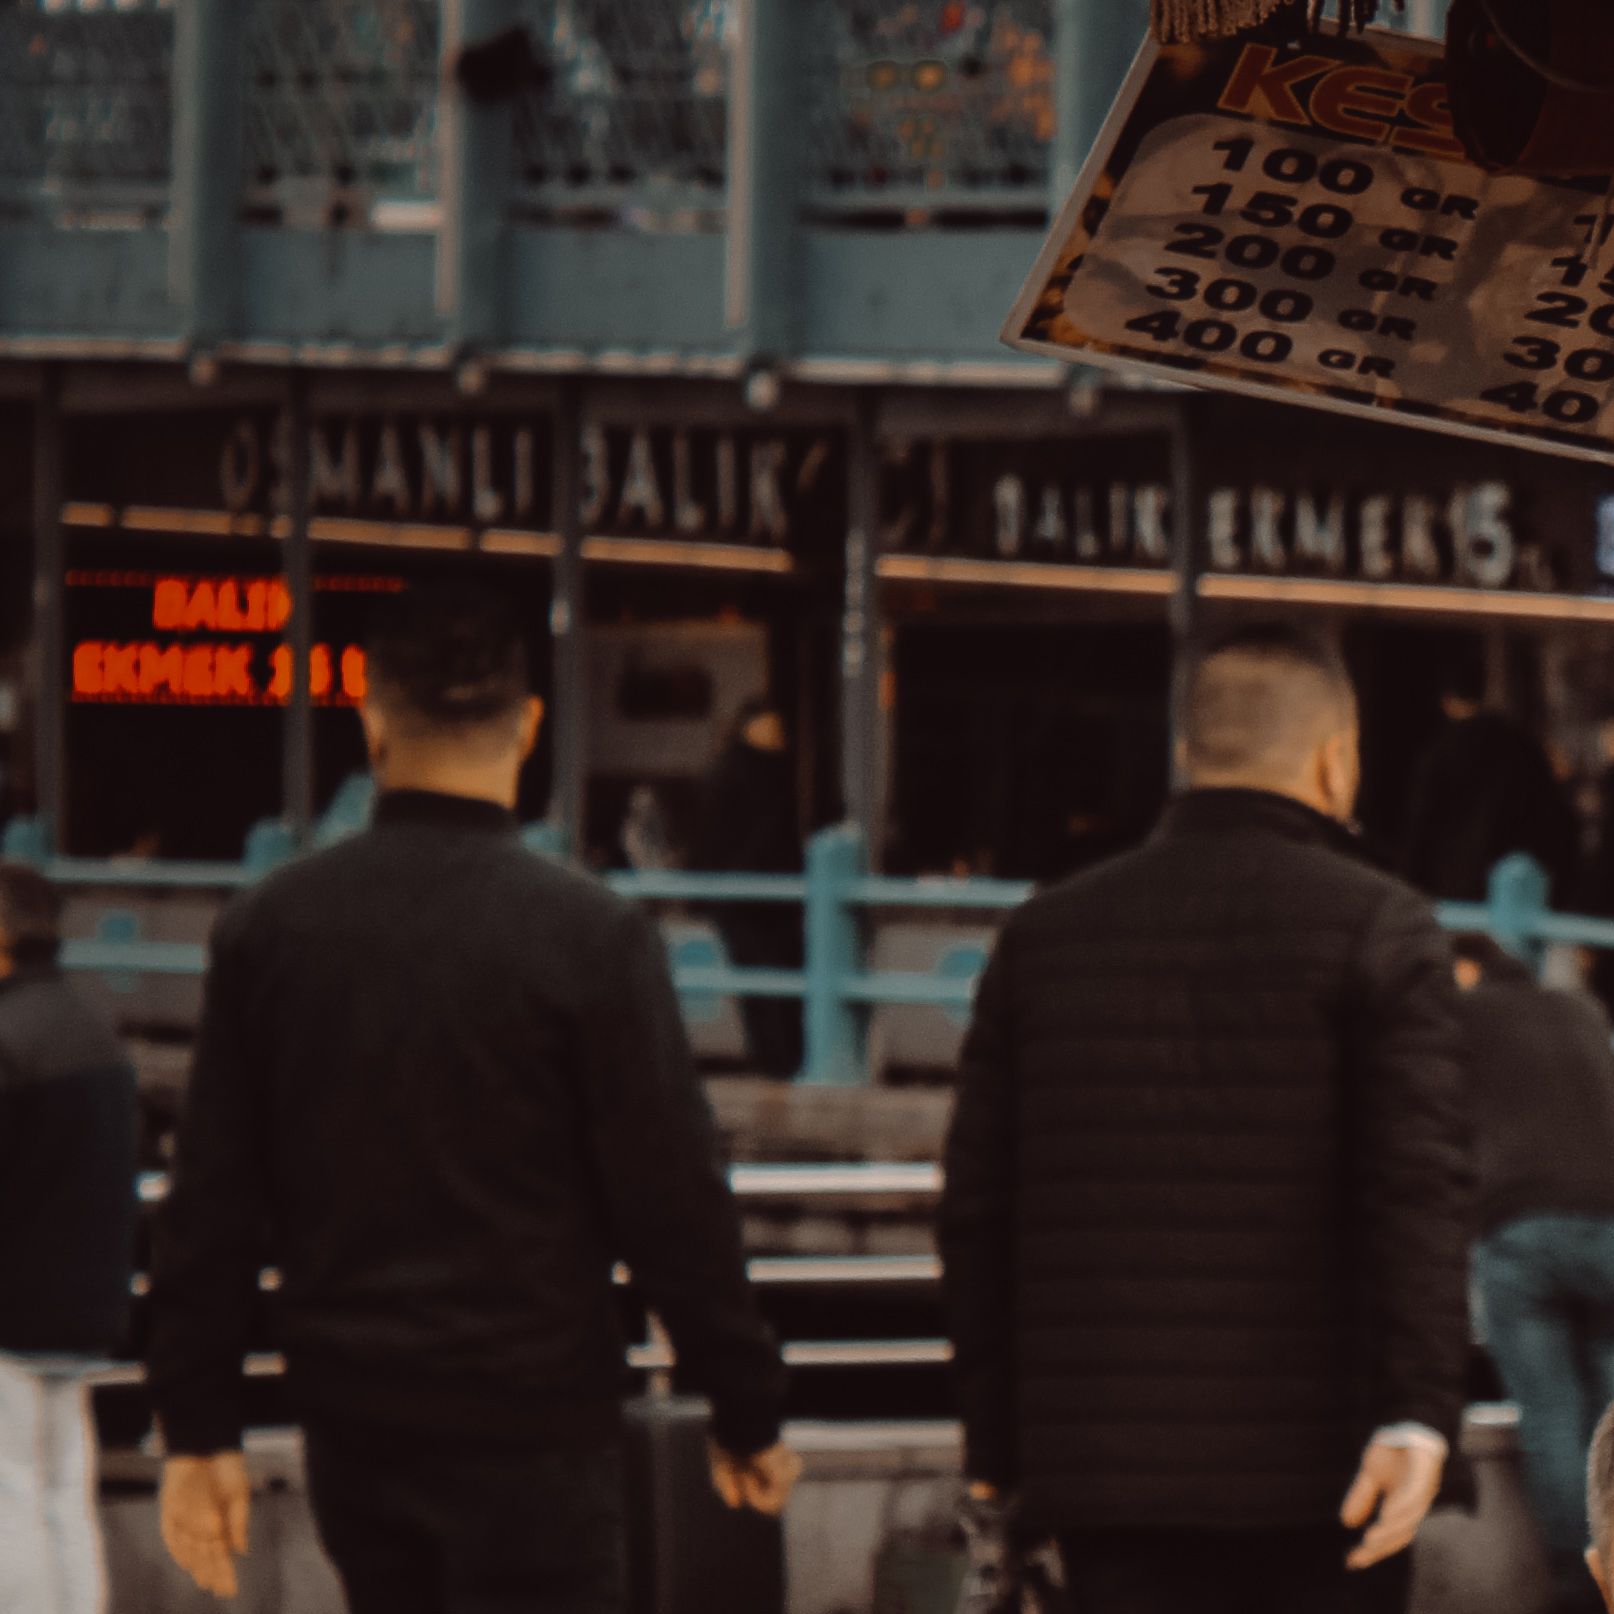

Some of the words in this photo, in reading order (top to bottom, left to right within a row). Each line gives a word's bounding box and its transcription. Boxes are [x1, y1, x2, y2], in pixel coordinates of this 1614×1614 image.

[1211, 137, 1373, 197] 100
[1401, 186, 1480, 222] GR
[1164, 222, 1335, 281] 200
[1358, 268, 1438, 303] GR
[1190, 182, 1353, 240] 150
[1380, 227, 1459, 263] GR
[1146, 265, 1313, 325] 300
[1337, 308, 1417, 342] GR
[1124, 308, 1292, 366] 400
[1317, 348, 1395, 379] GR
[1478, 379, 1599, 426] 40
